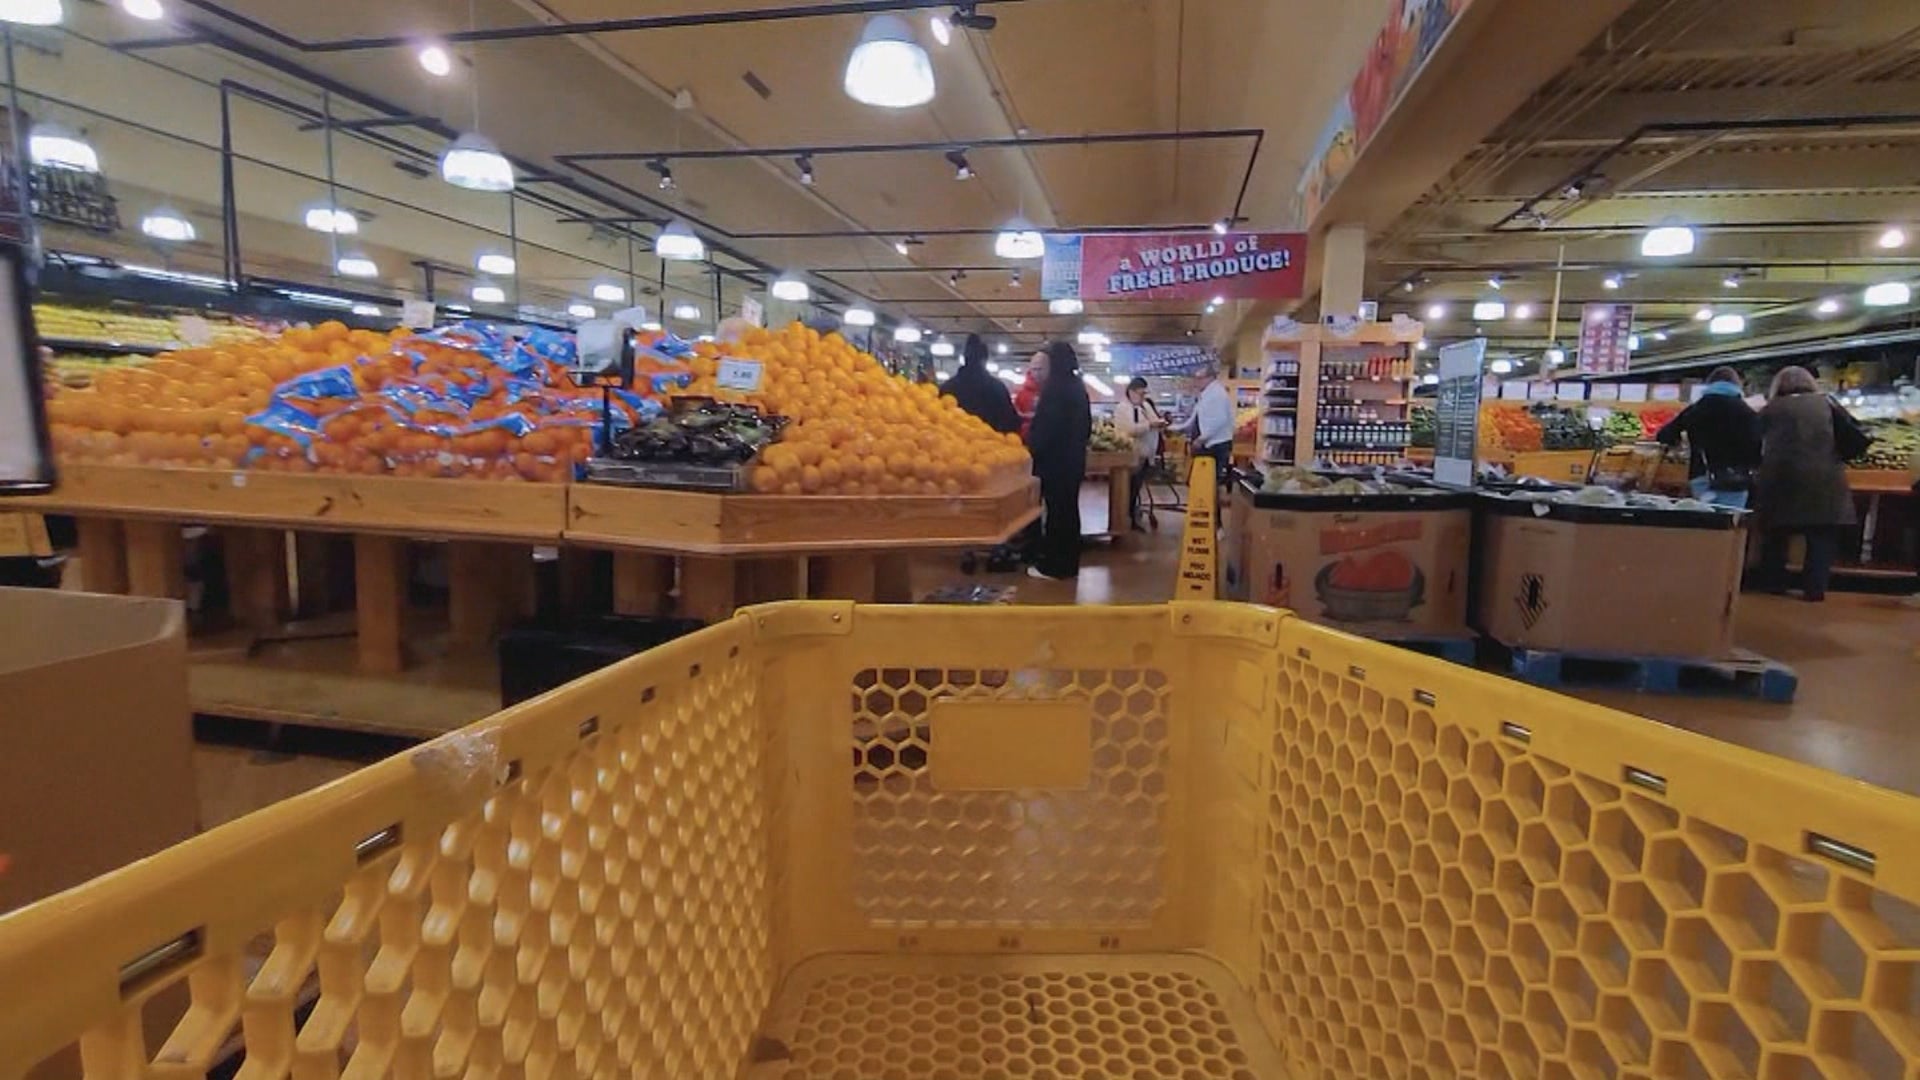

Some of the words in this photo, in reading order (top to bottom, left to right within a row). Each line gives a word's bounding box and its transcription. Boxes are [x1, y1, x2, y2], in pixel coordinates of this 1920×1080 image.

[1108, 268, 1176, 293] FRESH
[1181, 250, 1291, 282] PRODUCE!
[1120, 258, 1131, 270] a
[1140, 240, 1226, 267] WORLD
[1235, 235, 1258, 252] of
